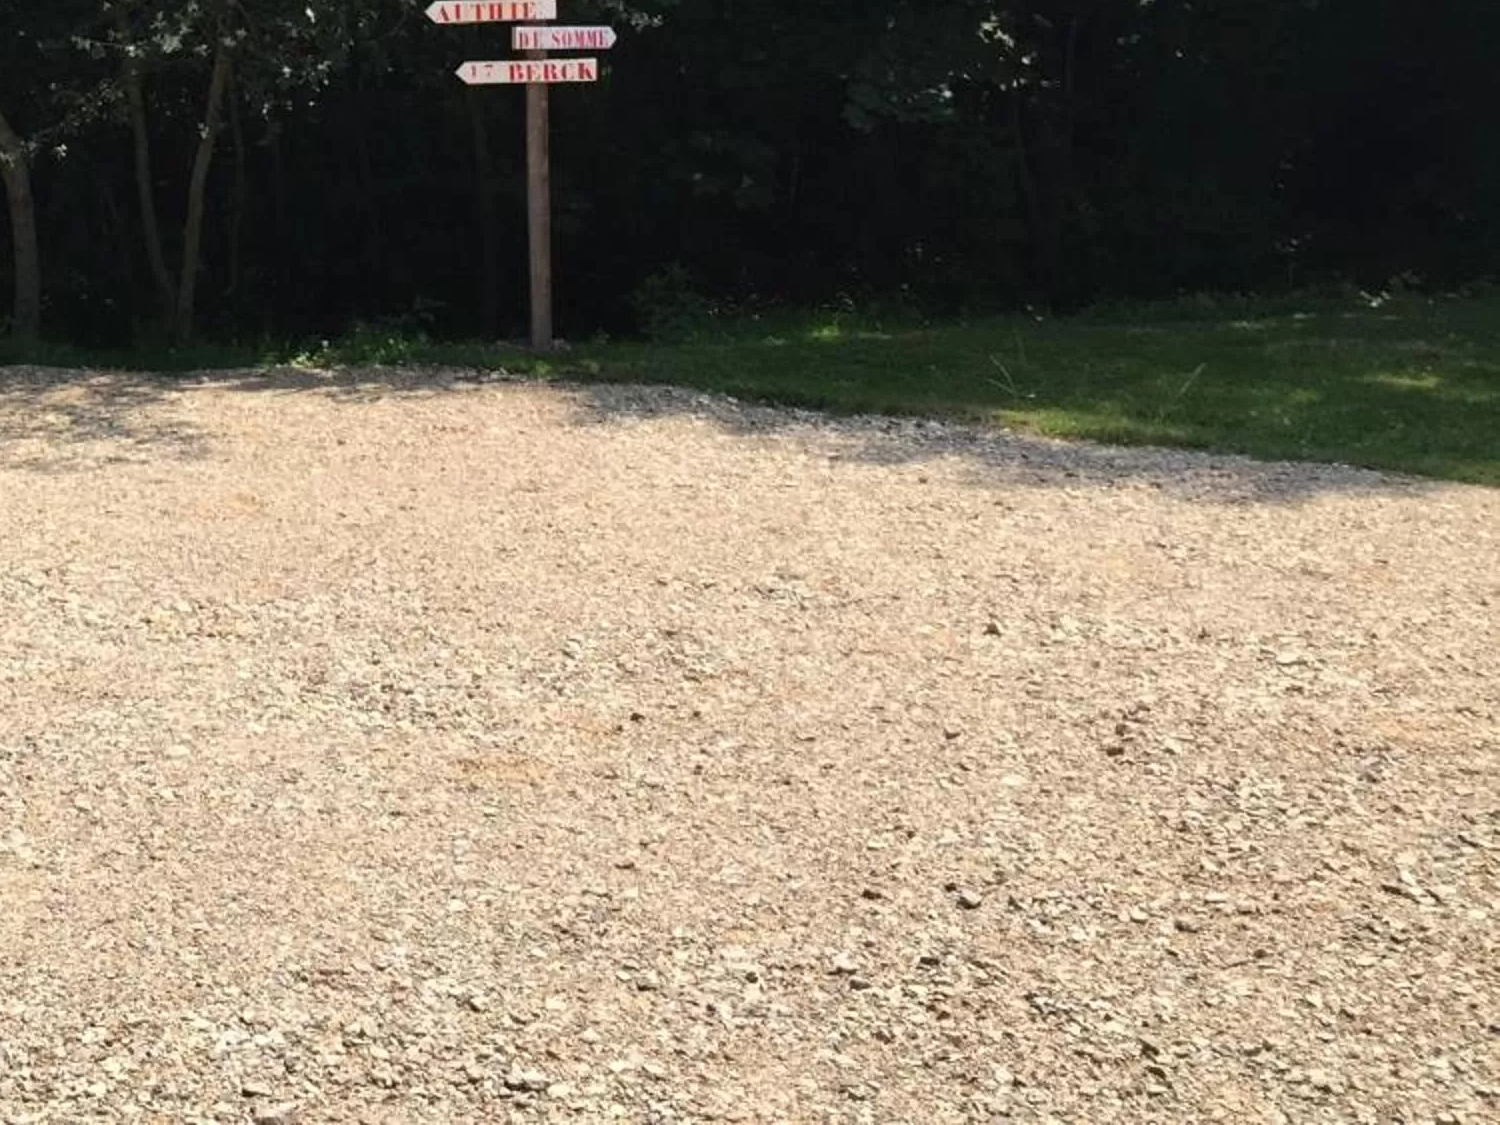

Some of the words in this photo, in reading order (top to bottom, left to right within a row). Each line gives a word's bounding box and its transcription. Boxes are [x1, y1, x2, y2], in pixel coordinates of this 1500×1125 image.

[437, 2, 536, 22] AUTHIE
[551, 29, 609, 48] SOMME
[508, 62, 594, 82] BERCK
